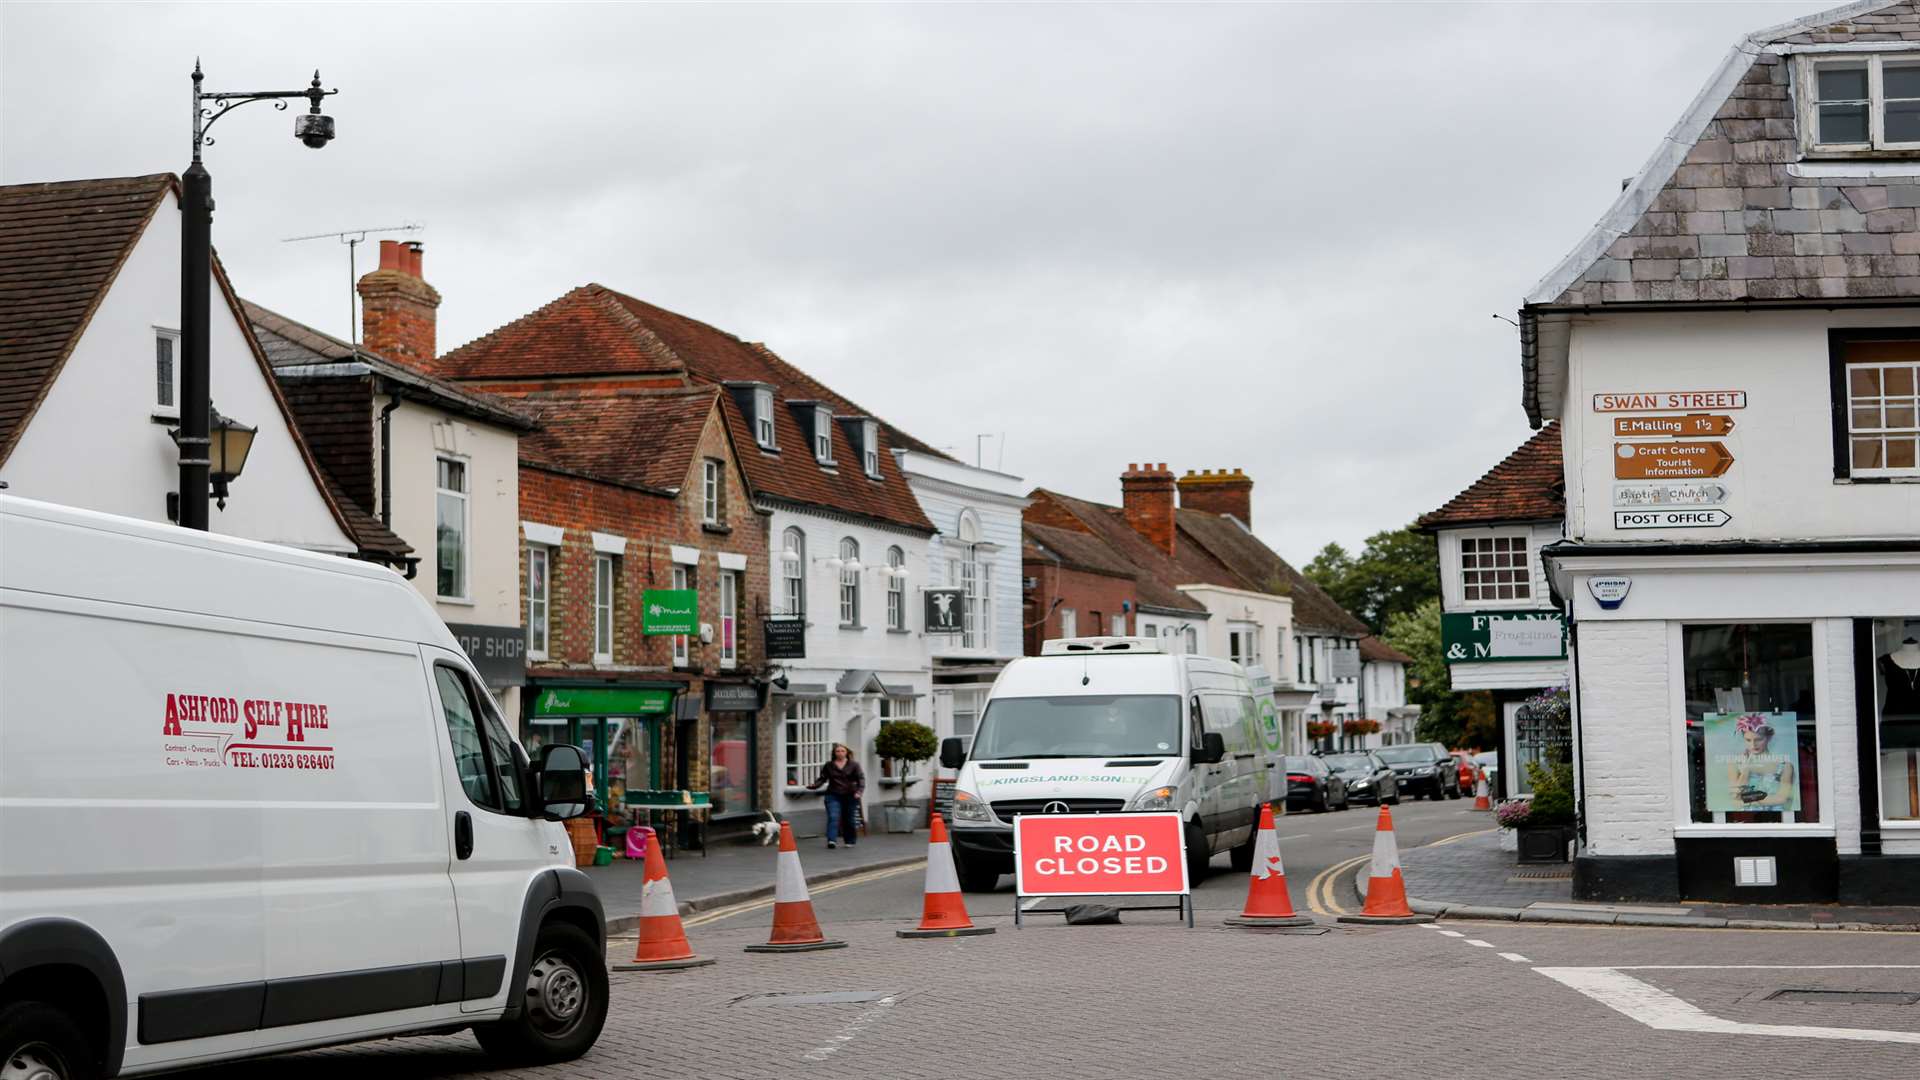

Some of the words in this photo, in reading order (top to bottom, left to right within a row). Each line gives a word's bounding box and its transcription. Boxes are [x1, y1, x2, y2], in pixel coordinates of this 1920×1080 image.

[1603, 395, 1657, 409] SWAN
[1668, 393, 1738, 408] STREET
[1619, 419, 1682, 432] E.Malling
[1638, 446, 1667, 455] Craft
[1670, 446, 1706, 455] Centre
[1656, 458, 1692, 467] Tourist
[1645, 466, 1704, 476] Information
[1669, 486, 1709, 499] Church
[1623, 513, 1661, 524] POST
[1667, 512, 1715, 523] OFFICE
[456, 635, 480, 656] OP
[485, 637, 525, 657] SHOP
[163, 693, 239, 736] ASHFORD
[243, 699, 283, 740] SELF
[285, 702, 329, 742] HIRE
[164, 743, 188, 752] Contract
[166, 757, 180, 766] Cars
[184, 757, 199, 767] Vans
[203, 758, 221, 767] Trucks
[231, 751, 260, 768] TEL:
[261, 752, 295, 769] 01233
[296, 753, 335, 770] 626407
[1054, 834, 1146, 853] ROAD
[1035, 856, 1168, 875] CLOSED
